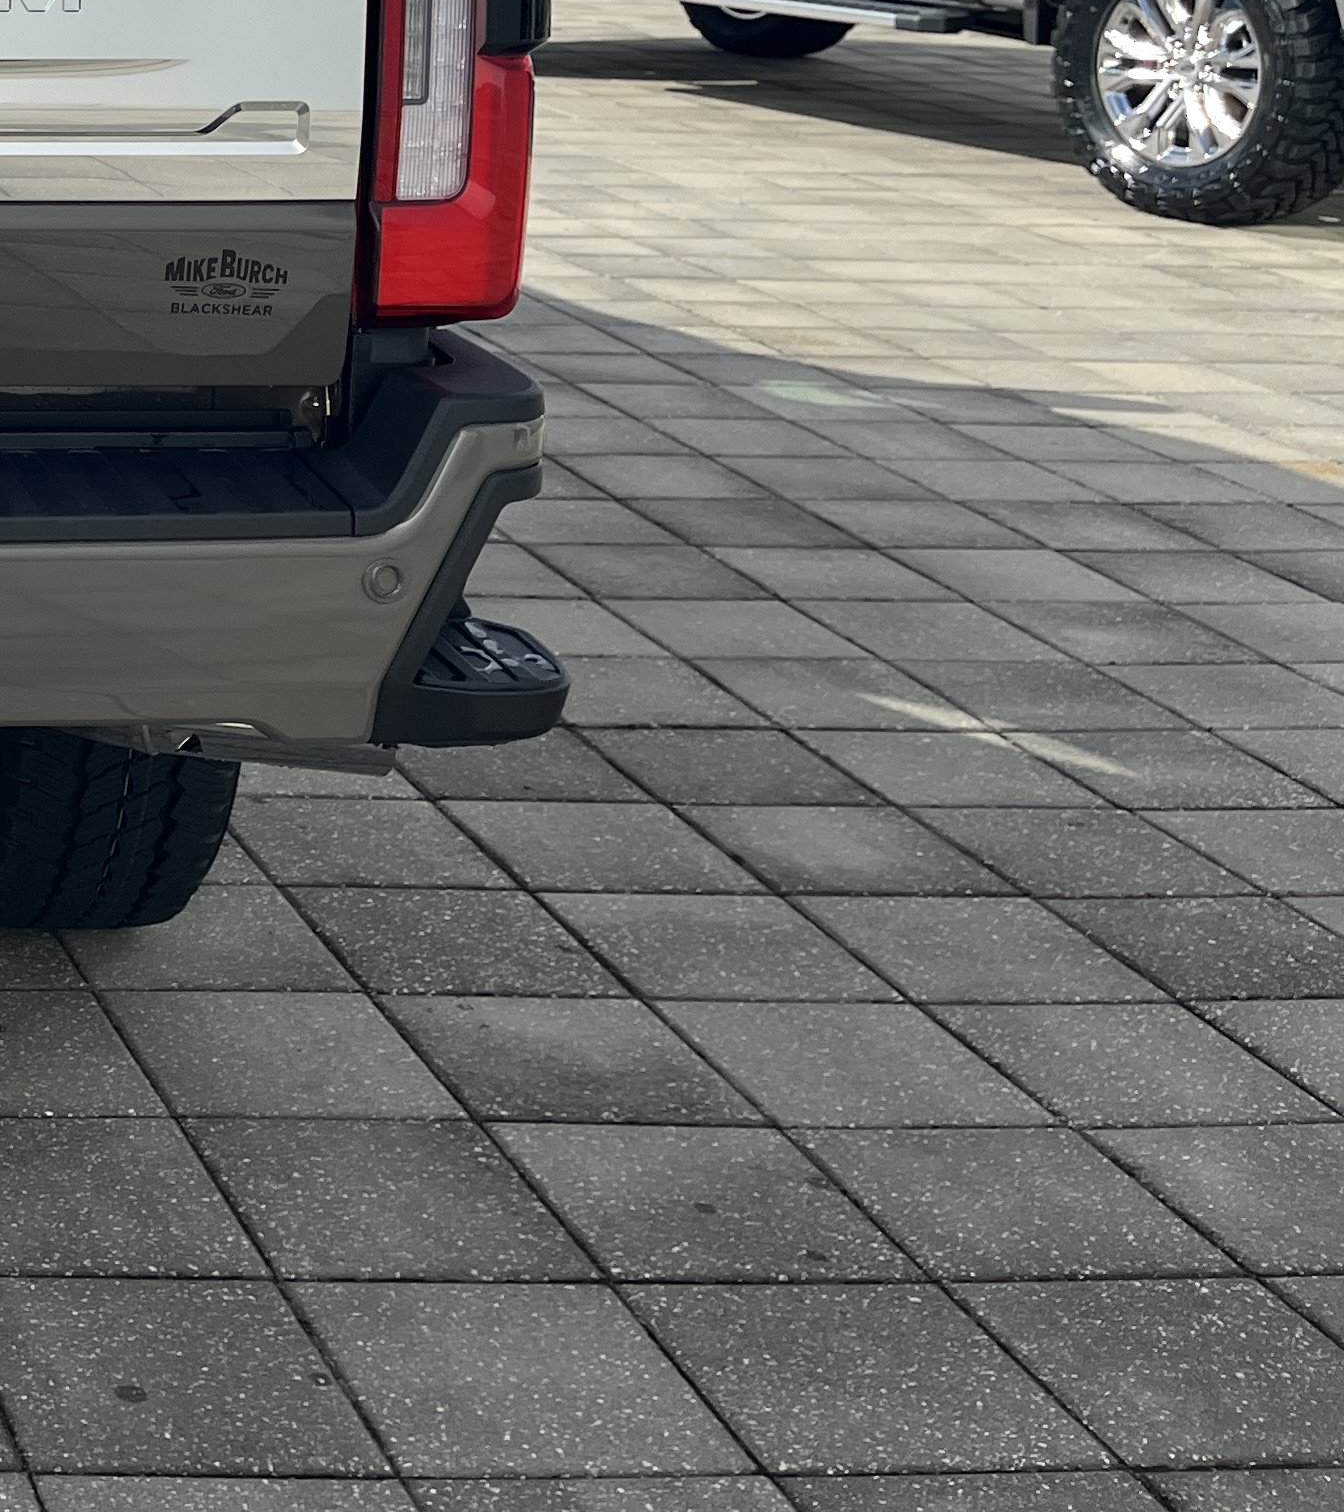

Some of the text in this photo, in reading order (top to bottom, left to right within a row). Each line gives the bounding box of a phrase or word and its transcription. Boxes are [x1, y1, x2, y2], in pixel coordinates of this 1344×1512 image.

[164, 249, 289, 285] MIKE BURCH
[209, 284, 237, 296] Ford
[170, 302, 273, 317] BLACKSHEAR
